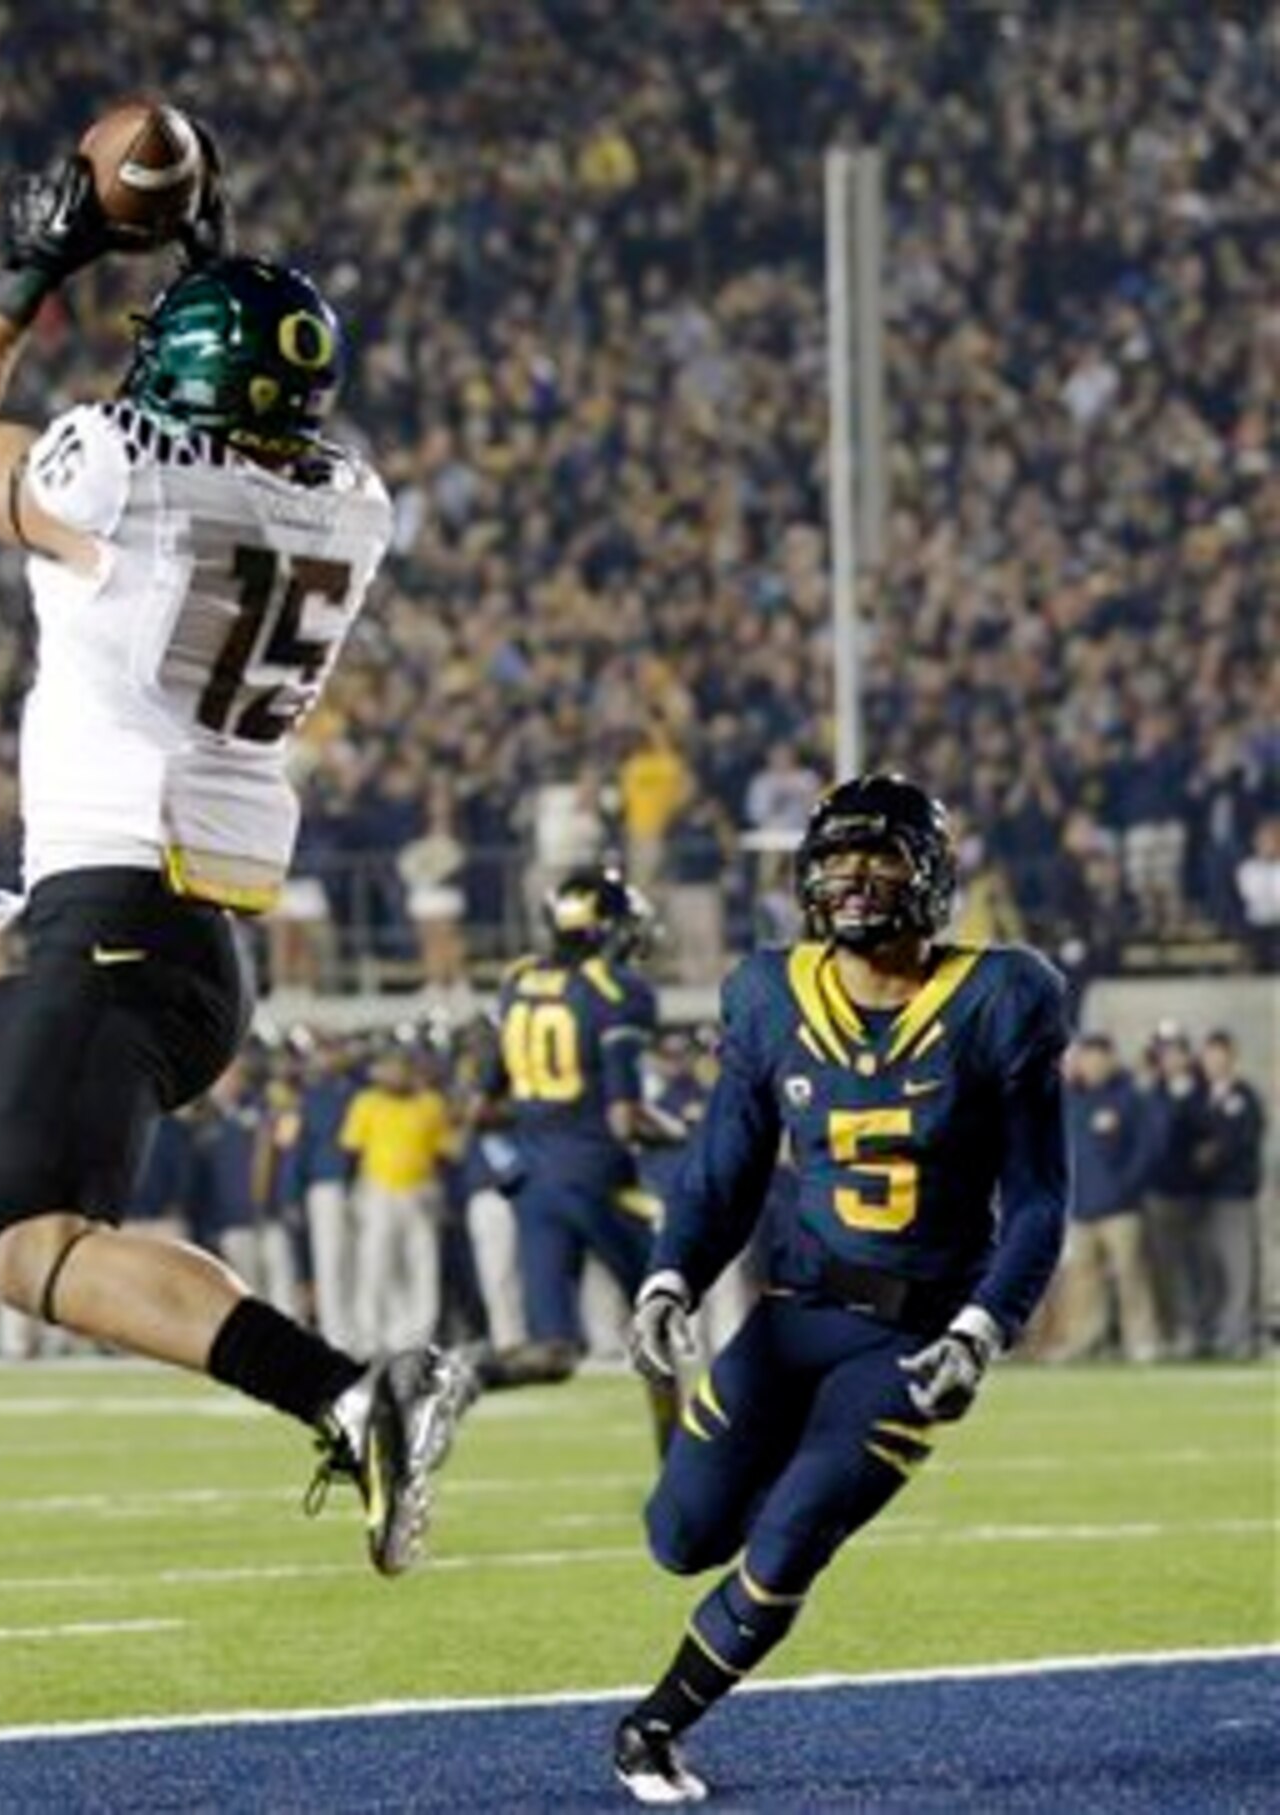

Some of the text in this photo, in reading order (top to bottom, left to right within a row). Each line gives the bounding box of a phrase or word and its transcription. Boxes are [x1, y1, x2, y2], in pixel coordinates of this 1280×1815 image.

[279, 312, 332, 367] O
[196, 545, 353, 742] 15
[503, 1002, 582, 1099] 10
[829, 1108, 917, 1230] 5
